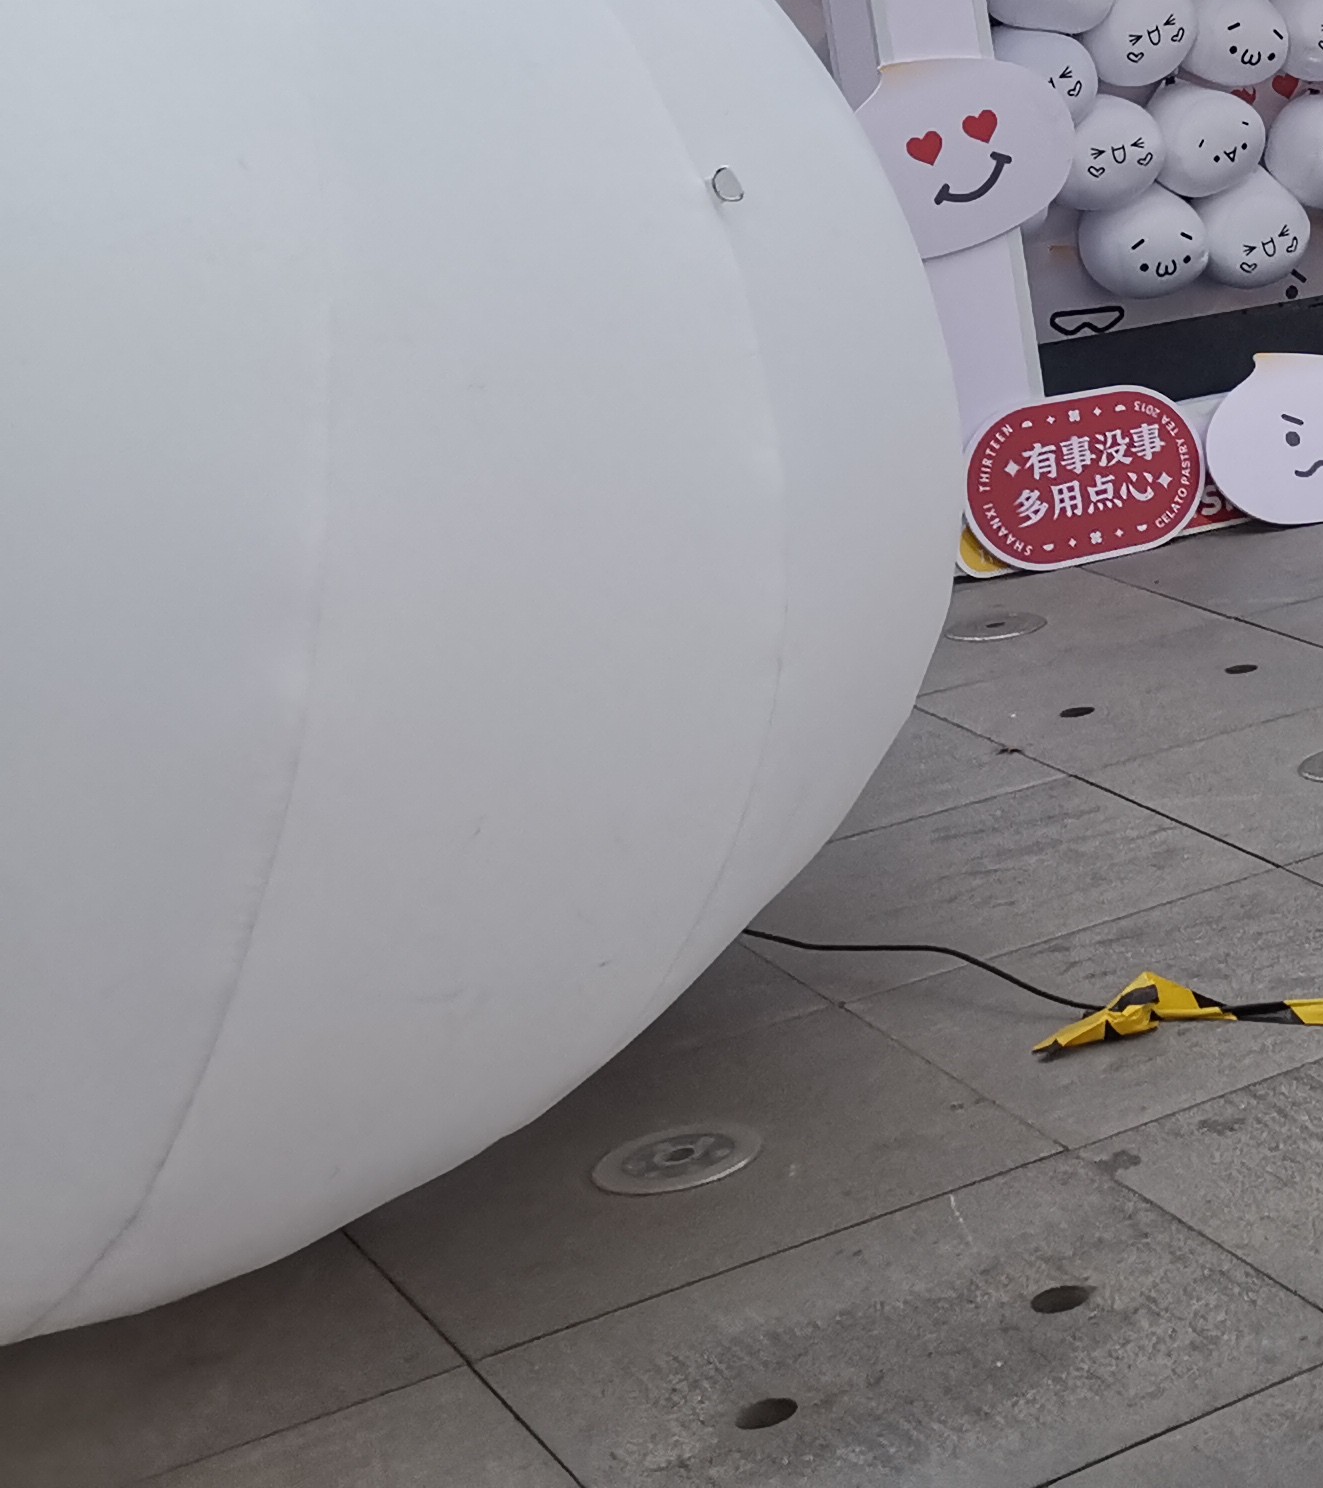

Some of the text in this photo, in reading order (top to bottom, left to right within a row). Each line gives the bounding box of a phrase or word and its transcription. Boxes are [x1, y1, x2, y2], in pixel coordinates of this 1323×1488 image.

[1022, 423, 1166, 480] 有事没事
[1161, 414, 1179, 436] TEA
[979, 423, 1014, 492] THIRTEEN
[1013, 471, 1155, 528] 多用点心
